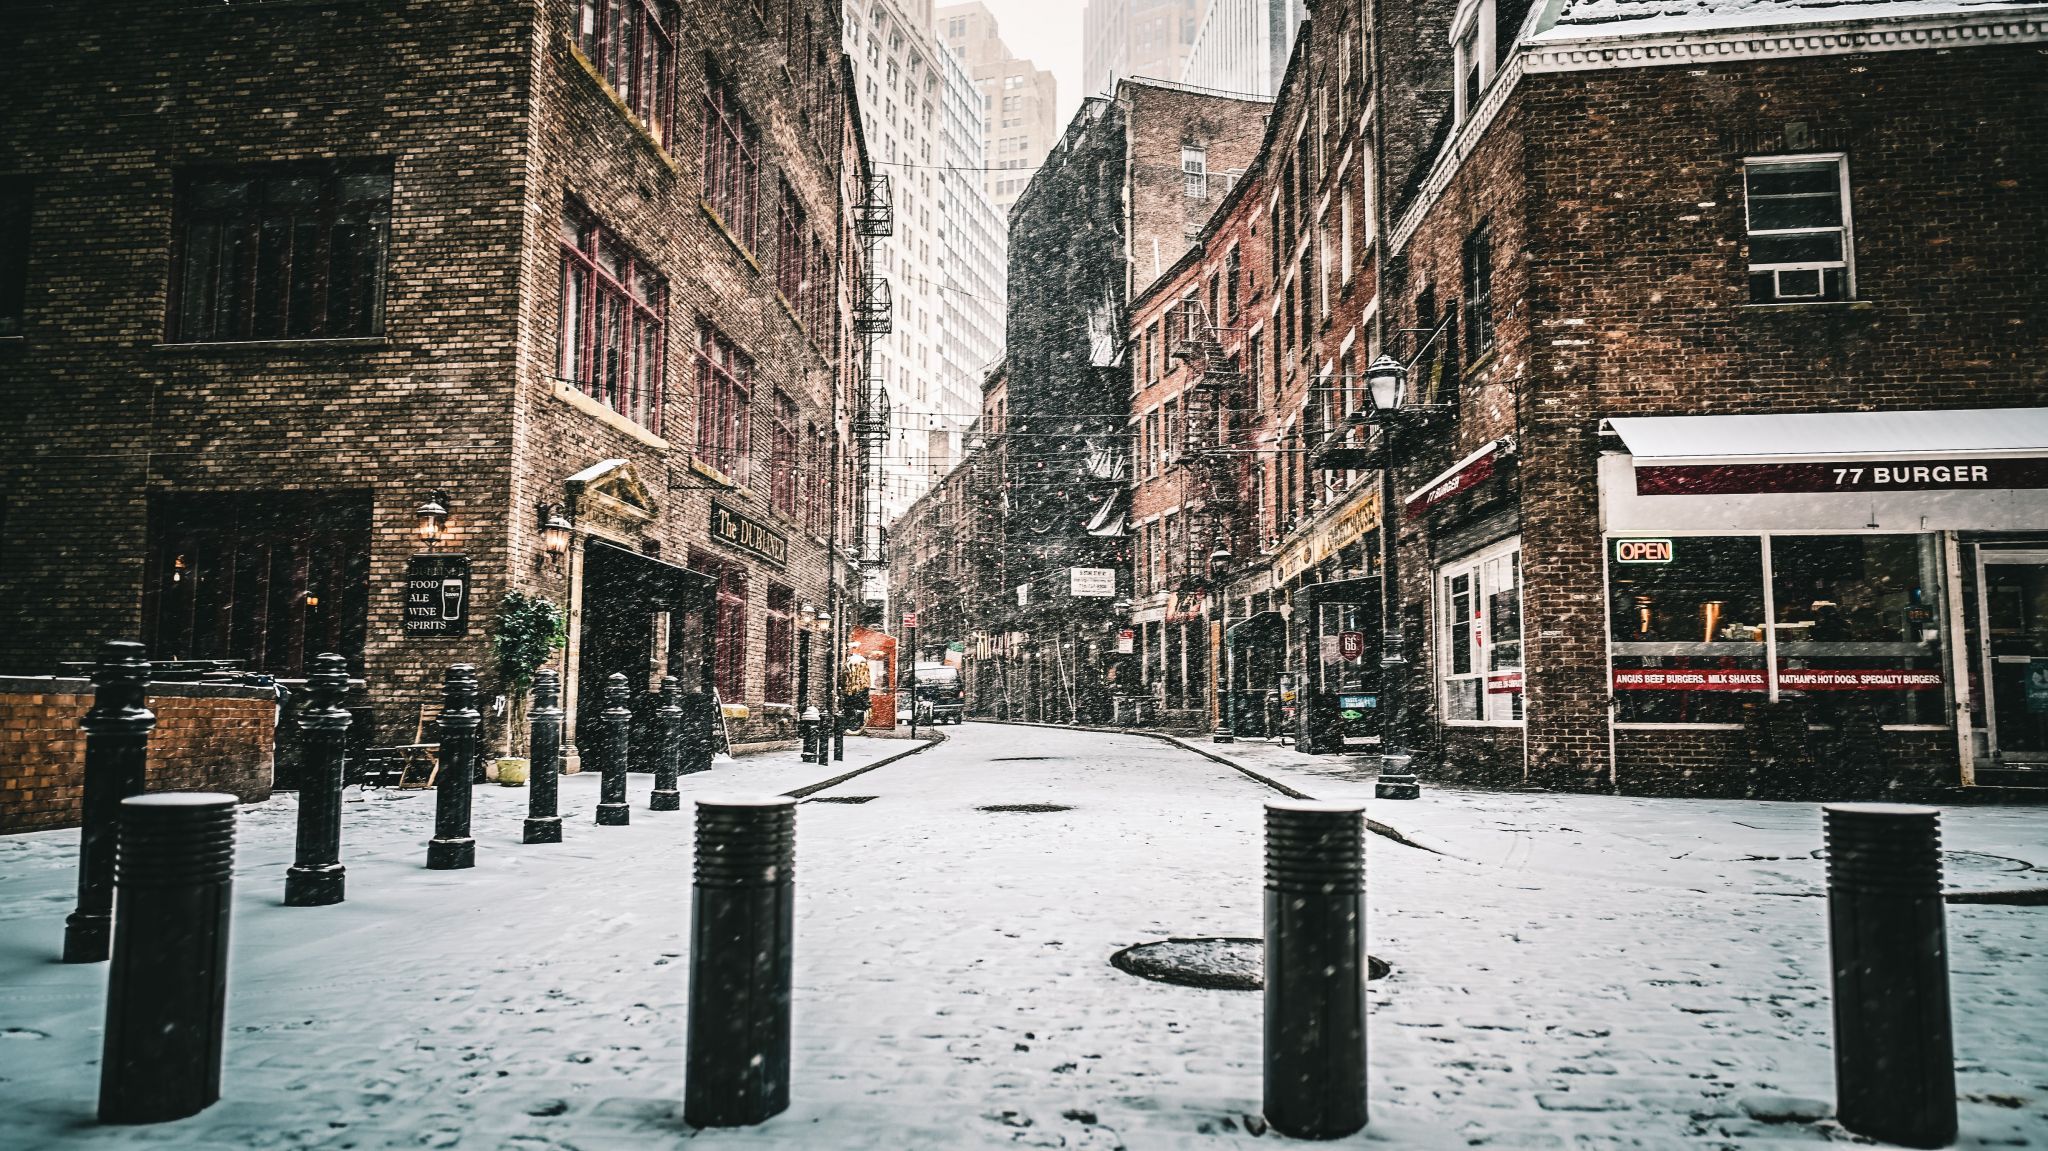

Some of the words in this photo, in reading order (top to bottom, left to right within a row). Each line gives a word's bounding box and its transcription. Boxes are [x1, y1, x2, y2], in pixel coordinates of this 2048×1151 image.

[1832, 467, 1864, 485] 77
[1873, 465, 1989, 484] BURGER
[718, 509, 737, 540] The
[740, 519, 785, 563] DUBLINER
[1619, 542, 1672, 560] OPEN
[410, 580, 439, 589] FOOD
[408, 593, 430, 602] ALE
[408, 607, 437, 616] WINE
[407, 621, 447, 630] SPIRITS
[1344, 636, 1357, 651] 66
[1616, 674, 1643, 684] ANGUS
[1644, 674, 1665, 684] BEEF
[1667, 674, 1706, 684] BURGERS.
[1708, 674, 1728, 684] MILK
[1729, 674, 1764, 684] SHAKES.
[1779, 674, 1817, 684] NATHAN'S
[1818, 674, 1835, 684] HOT
[1836, 674, 1859, 684] DOGS.
[1861, 674, 1902, 684] SPECIALTY
[1904, 674, 1942, 684] BURGERS.
